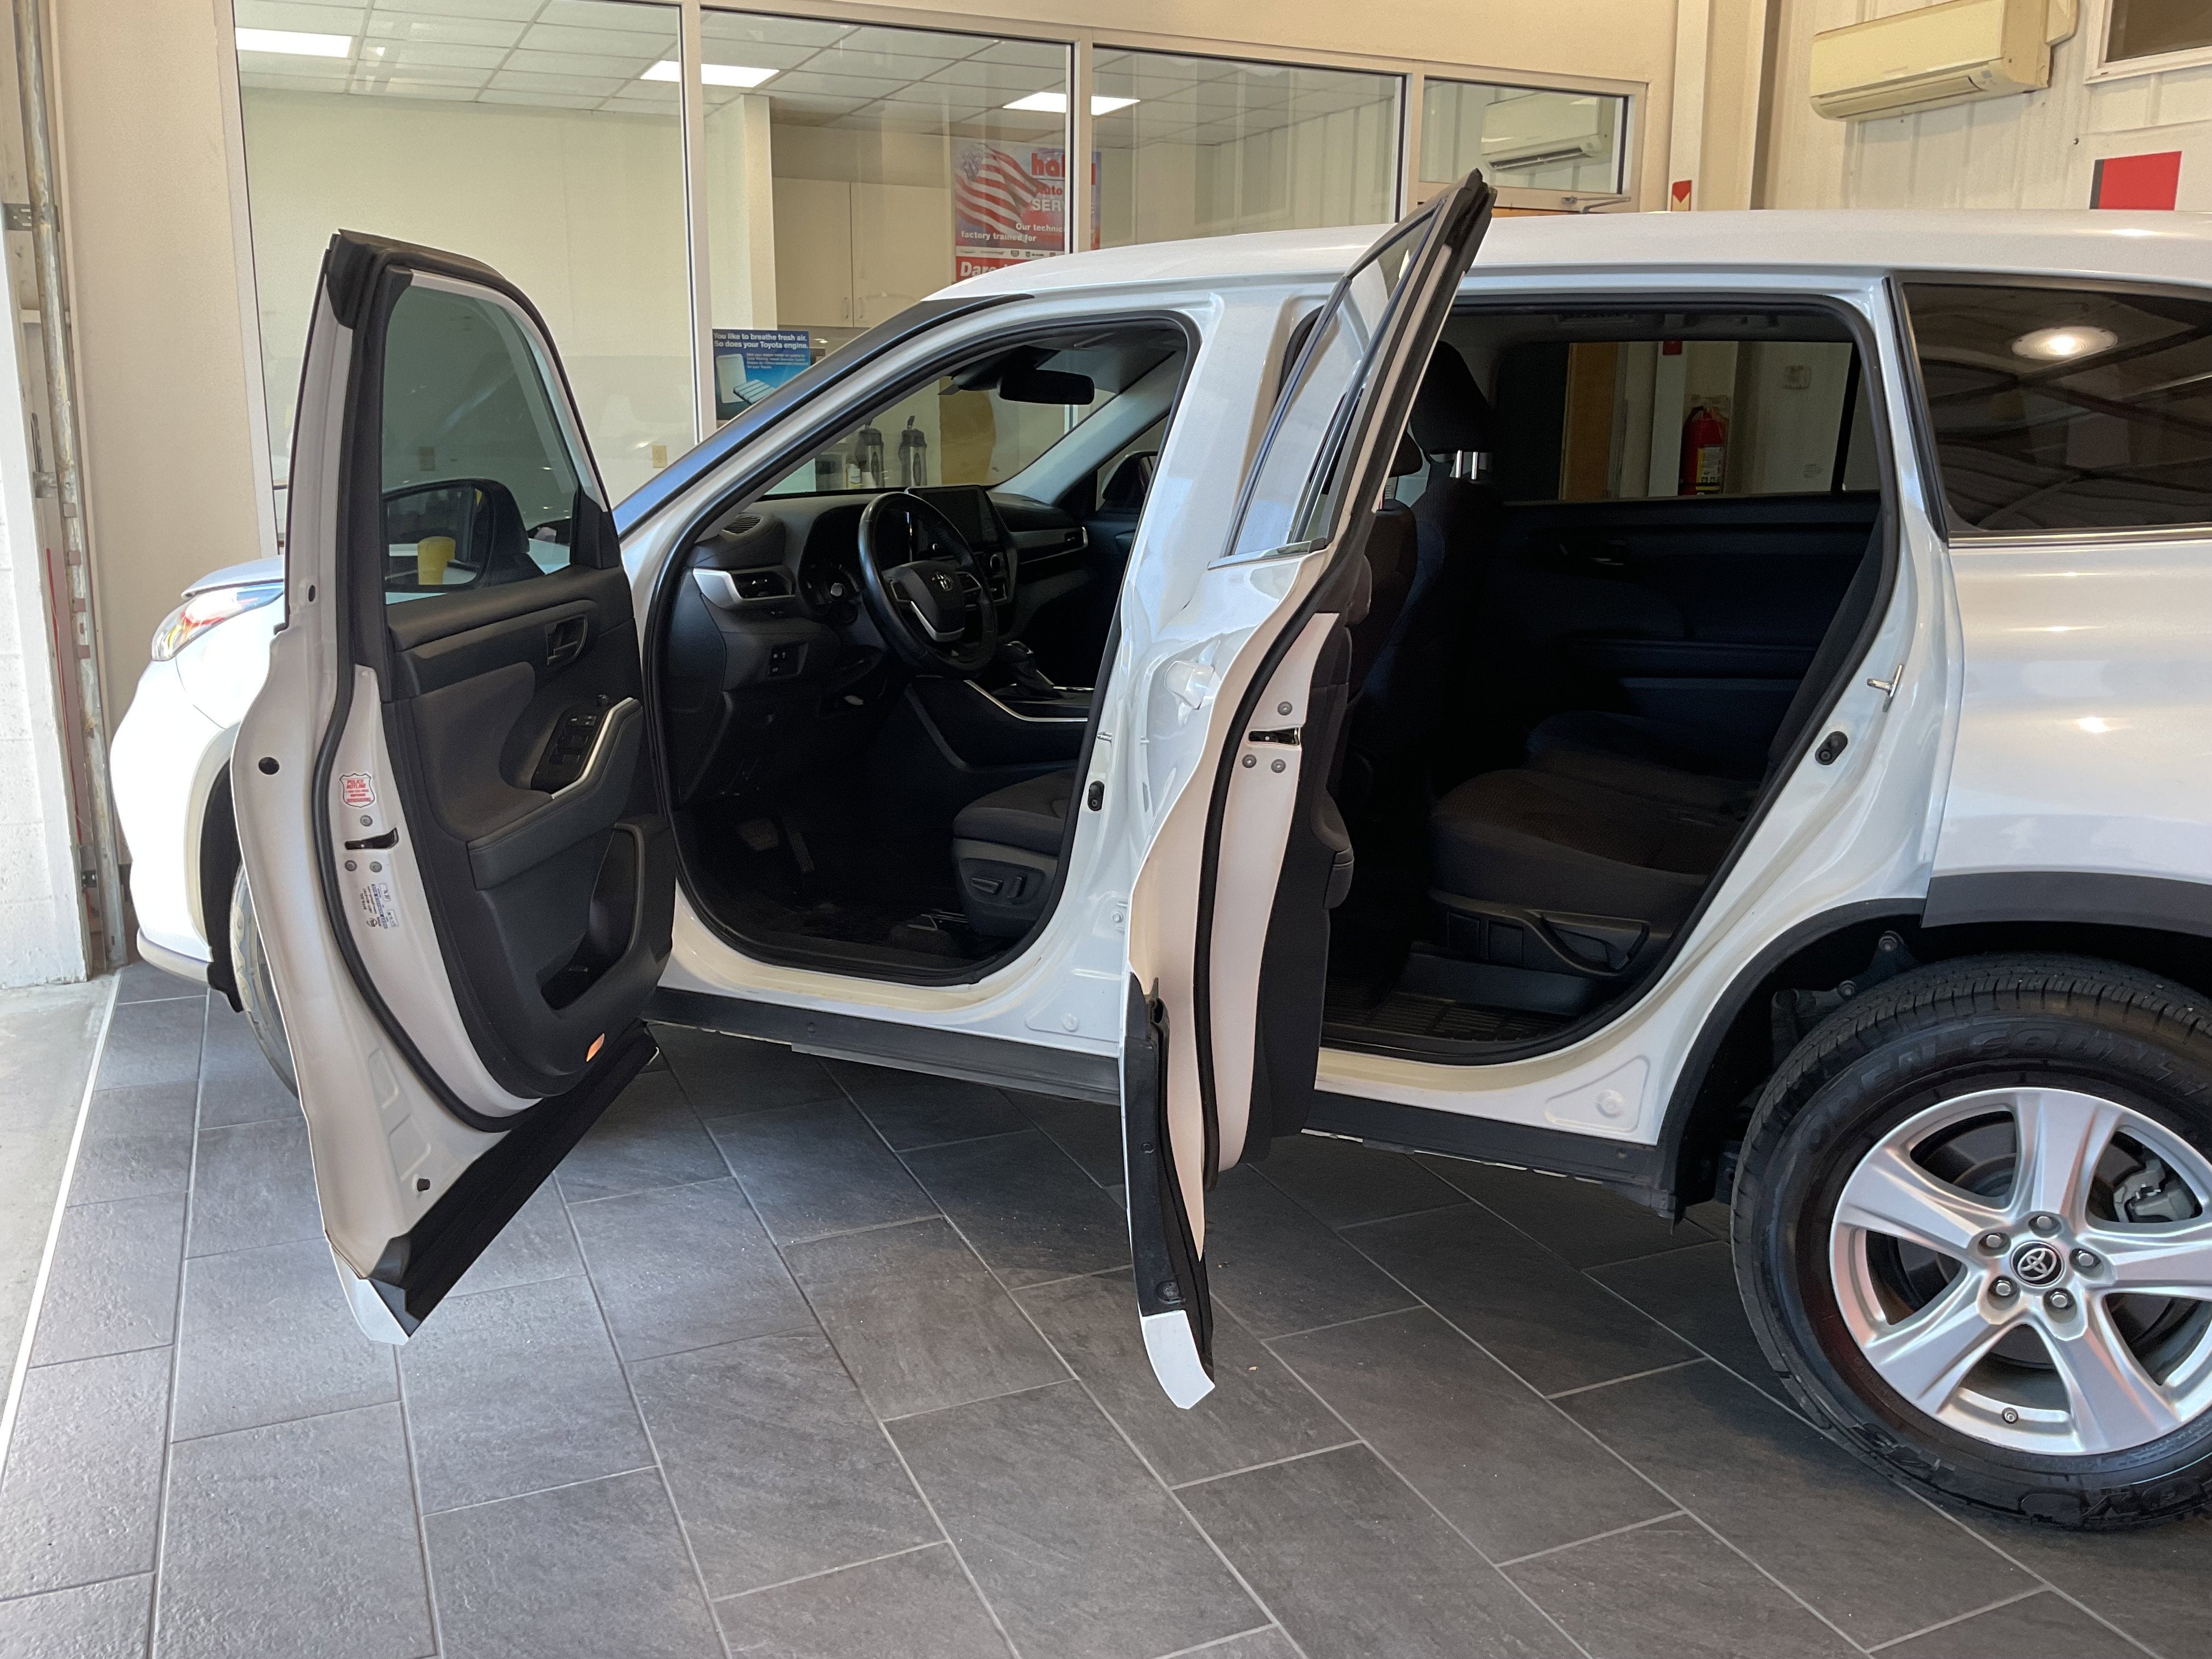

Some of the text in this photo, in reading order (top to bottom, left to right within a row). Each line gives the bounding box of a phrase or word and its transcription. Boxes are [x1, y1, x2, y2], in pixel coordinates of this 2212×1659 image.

[1016, 222, 1065, 233] Our technic
[961, 230, 1036, 243] factory trained for
[760, 341, 782, 349] Toyota
